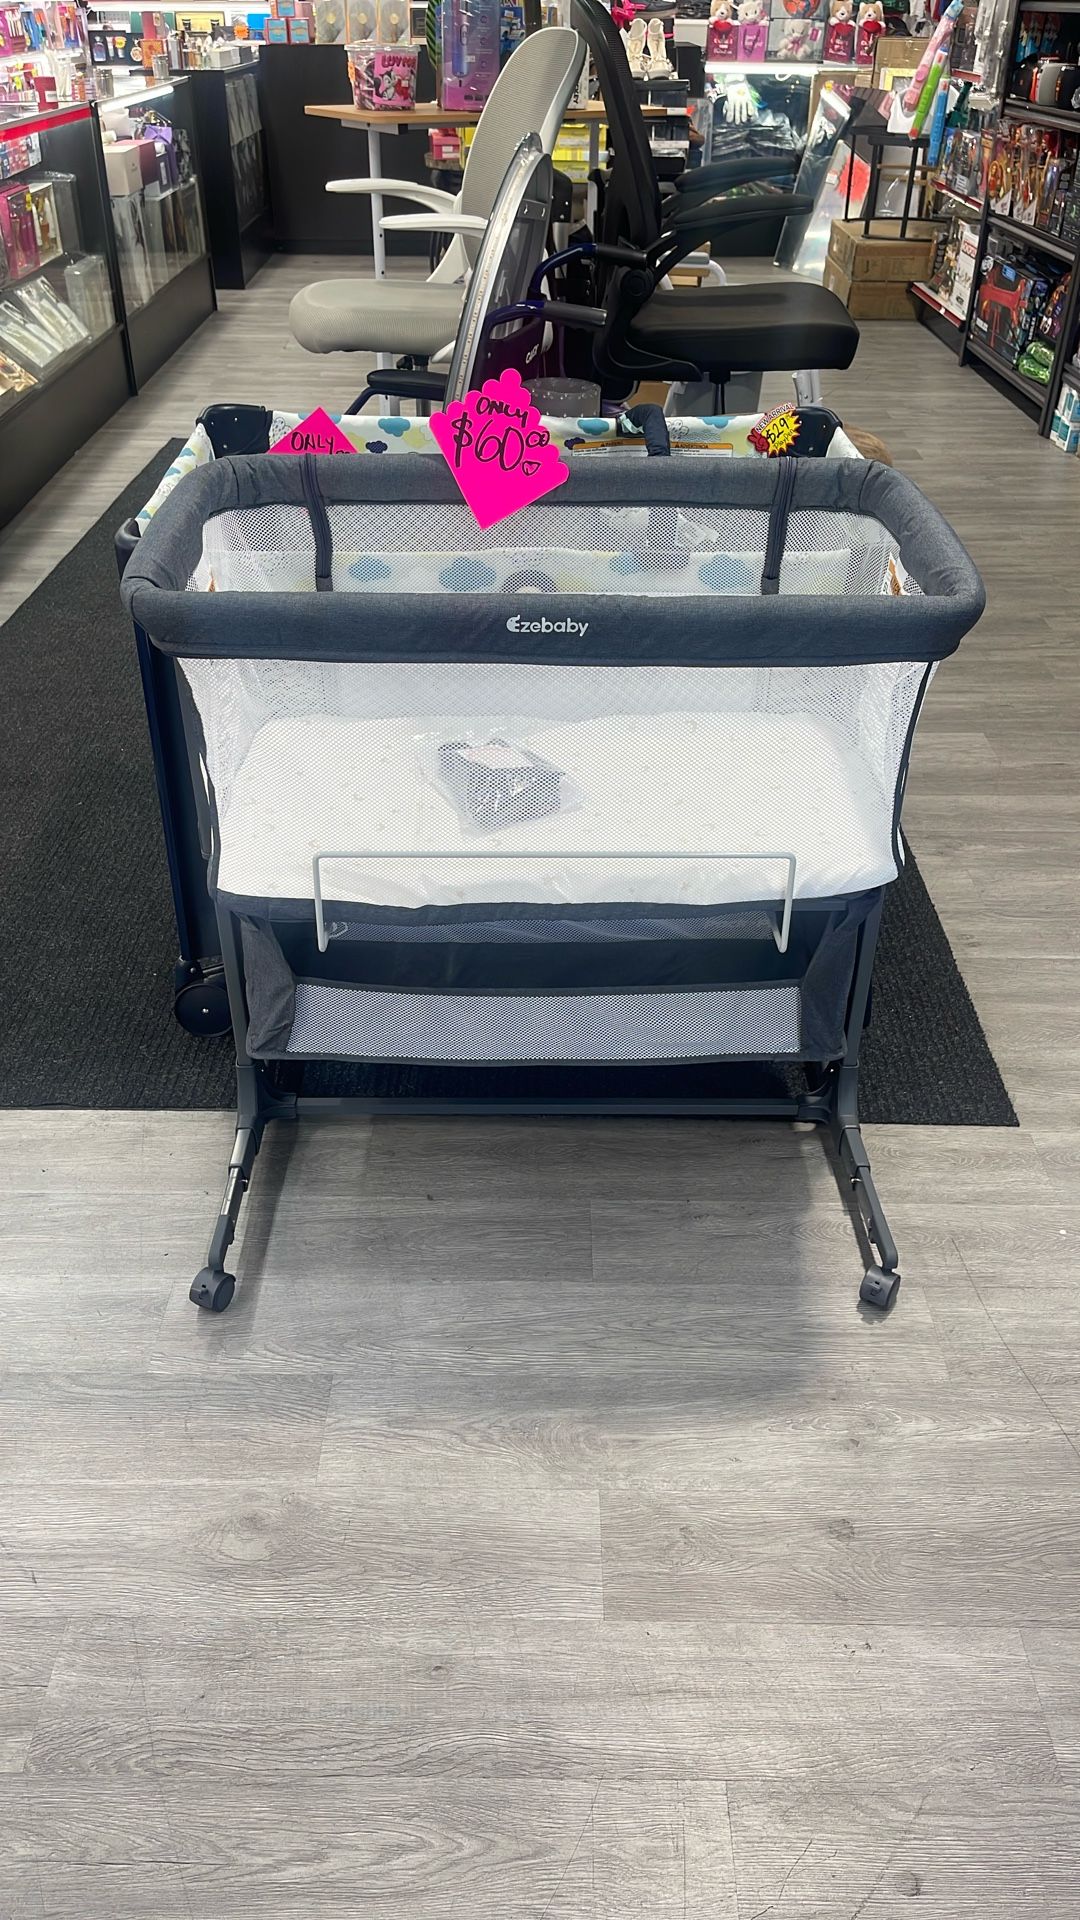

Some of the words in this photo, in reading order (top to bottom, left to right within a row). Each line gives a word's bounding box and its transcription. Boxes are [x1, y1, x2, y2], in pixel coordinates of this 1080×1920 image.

[476, 396, 529, 428] ONLY
[769, 402, 796, 420] ARRIVAL
[765, 417, 790, 444] $29
[291, 431, 334, 454] ONLY
[506, 614, 589, 637] Ezebaby
